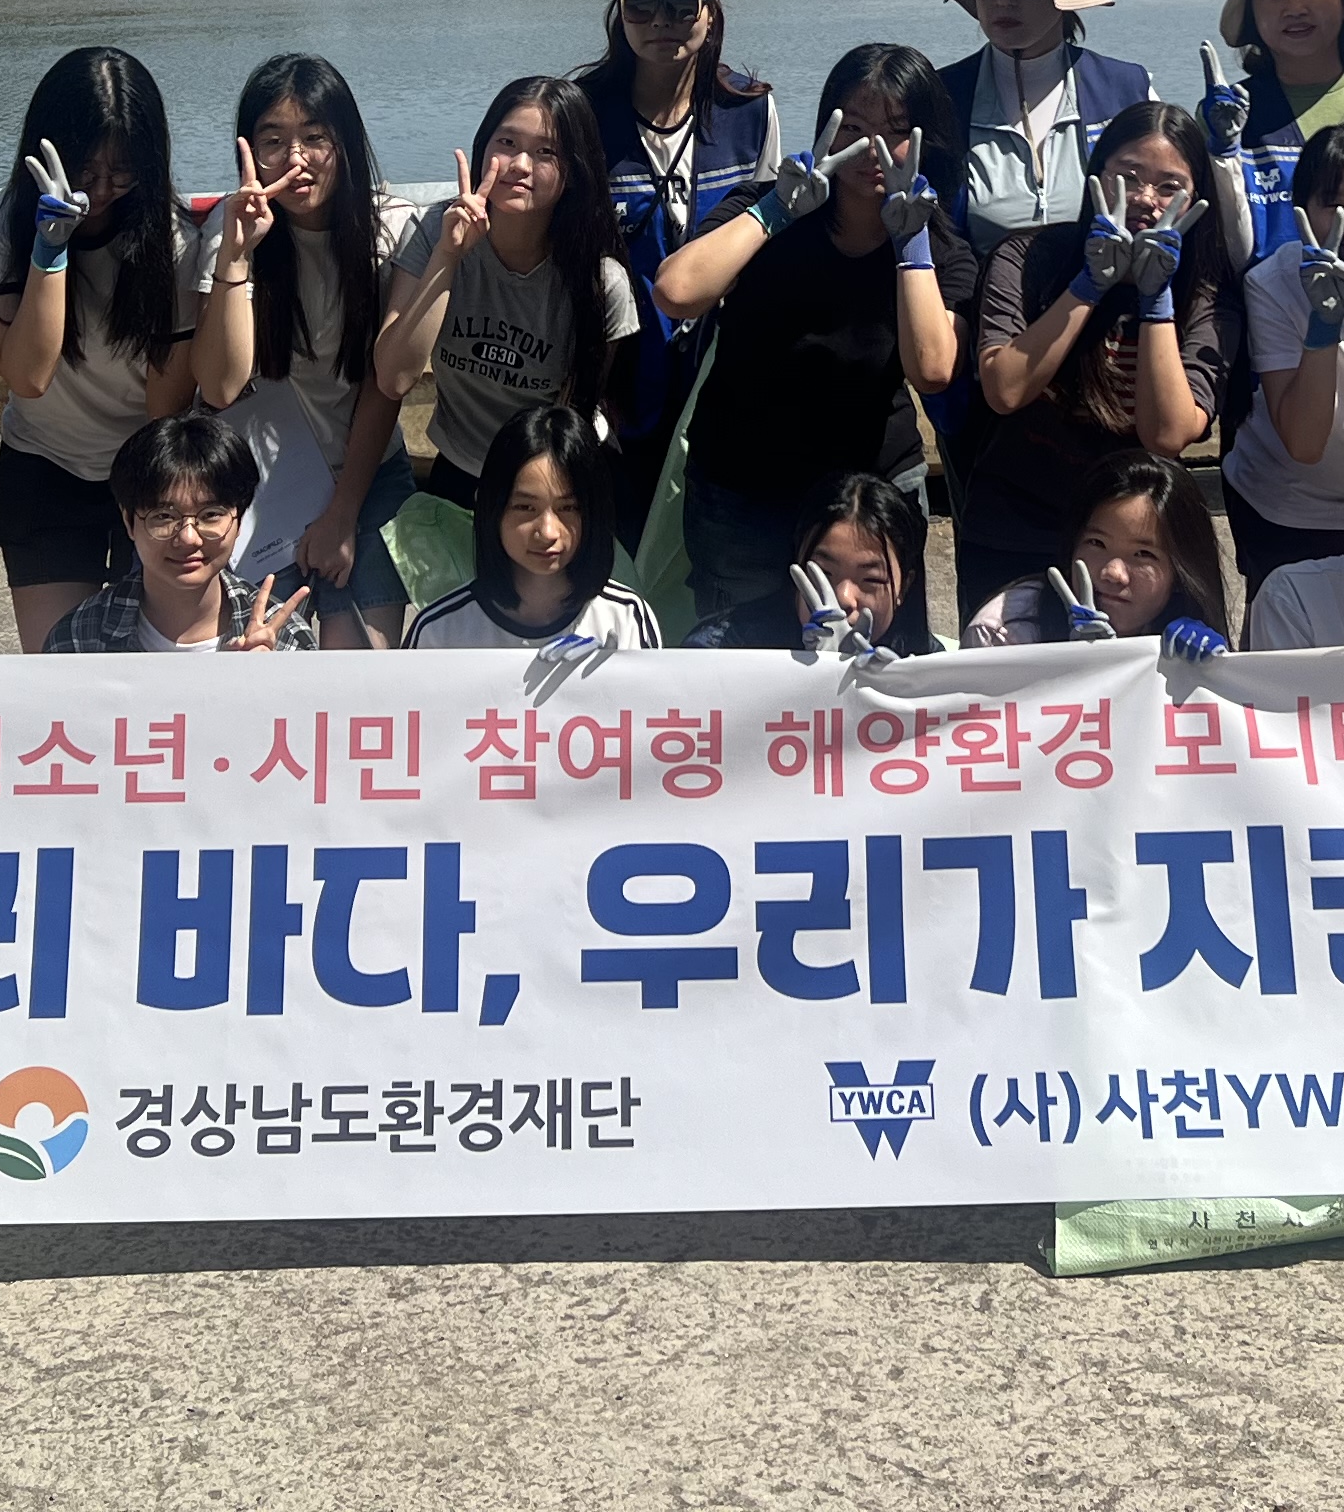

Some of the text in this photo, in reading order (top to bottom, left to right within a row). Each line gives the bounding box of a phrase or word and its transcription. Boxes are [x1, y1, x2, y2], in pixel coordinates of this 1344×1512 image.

[440, 346, 502, 382] BOSTON
[451, 315, 554, 364] ALLSTON
[480, 343, 517, 366] 1630
[463, 708, 724, 801] 참여형
[765, 698, 1115, 796] 해양환경
[139, 842, 520, 1024] 바다,
[582, 831, 1087, 1008] 우리가
[115, 1077, 642, 1159] 경상남도환경재단
[837, 1090, 928, 1117] YWCA
[969, 1071, 1083, 1147] (사)
